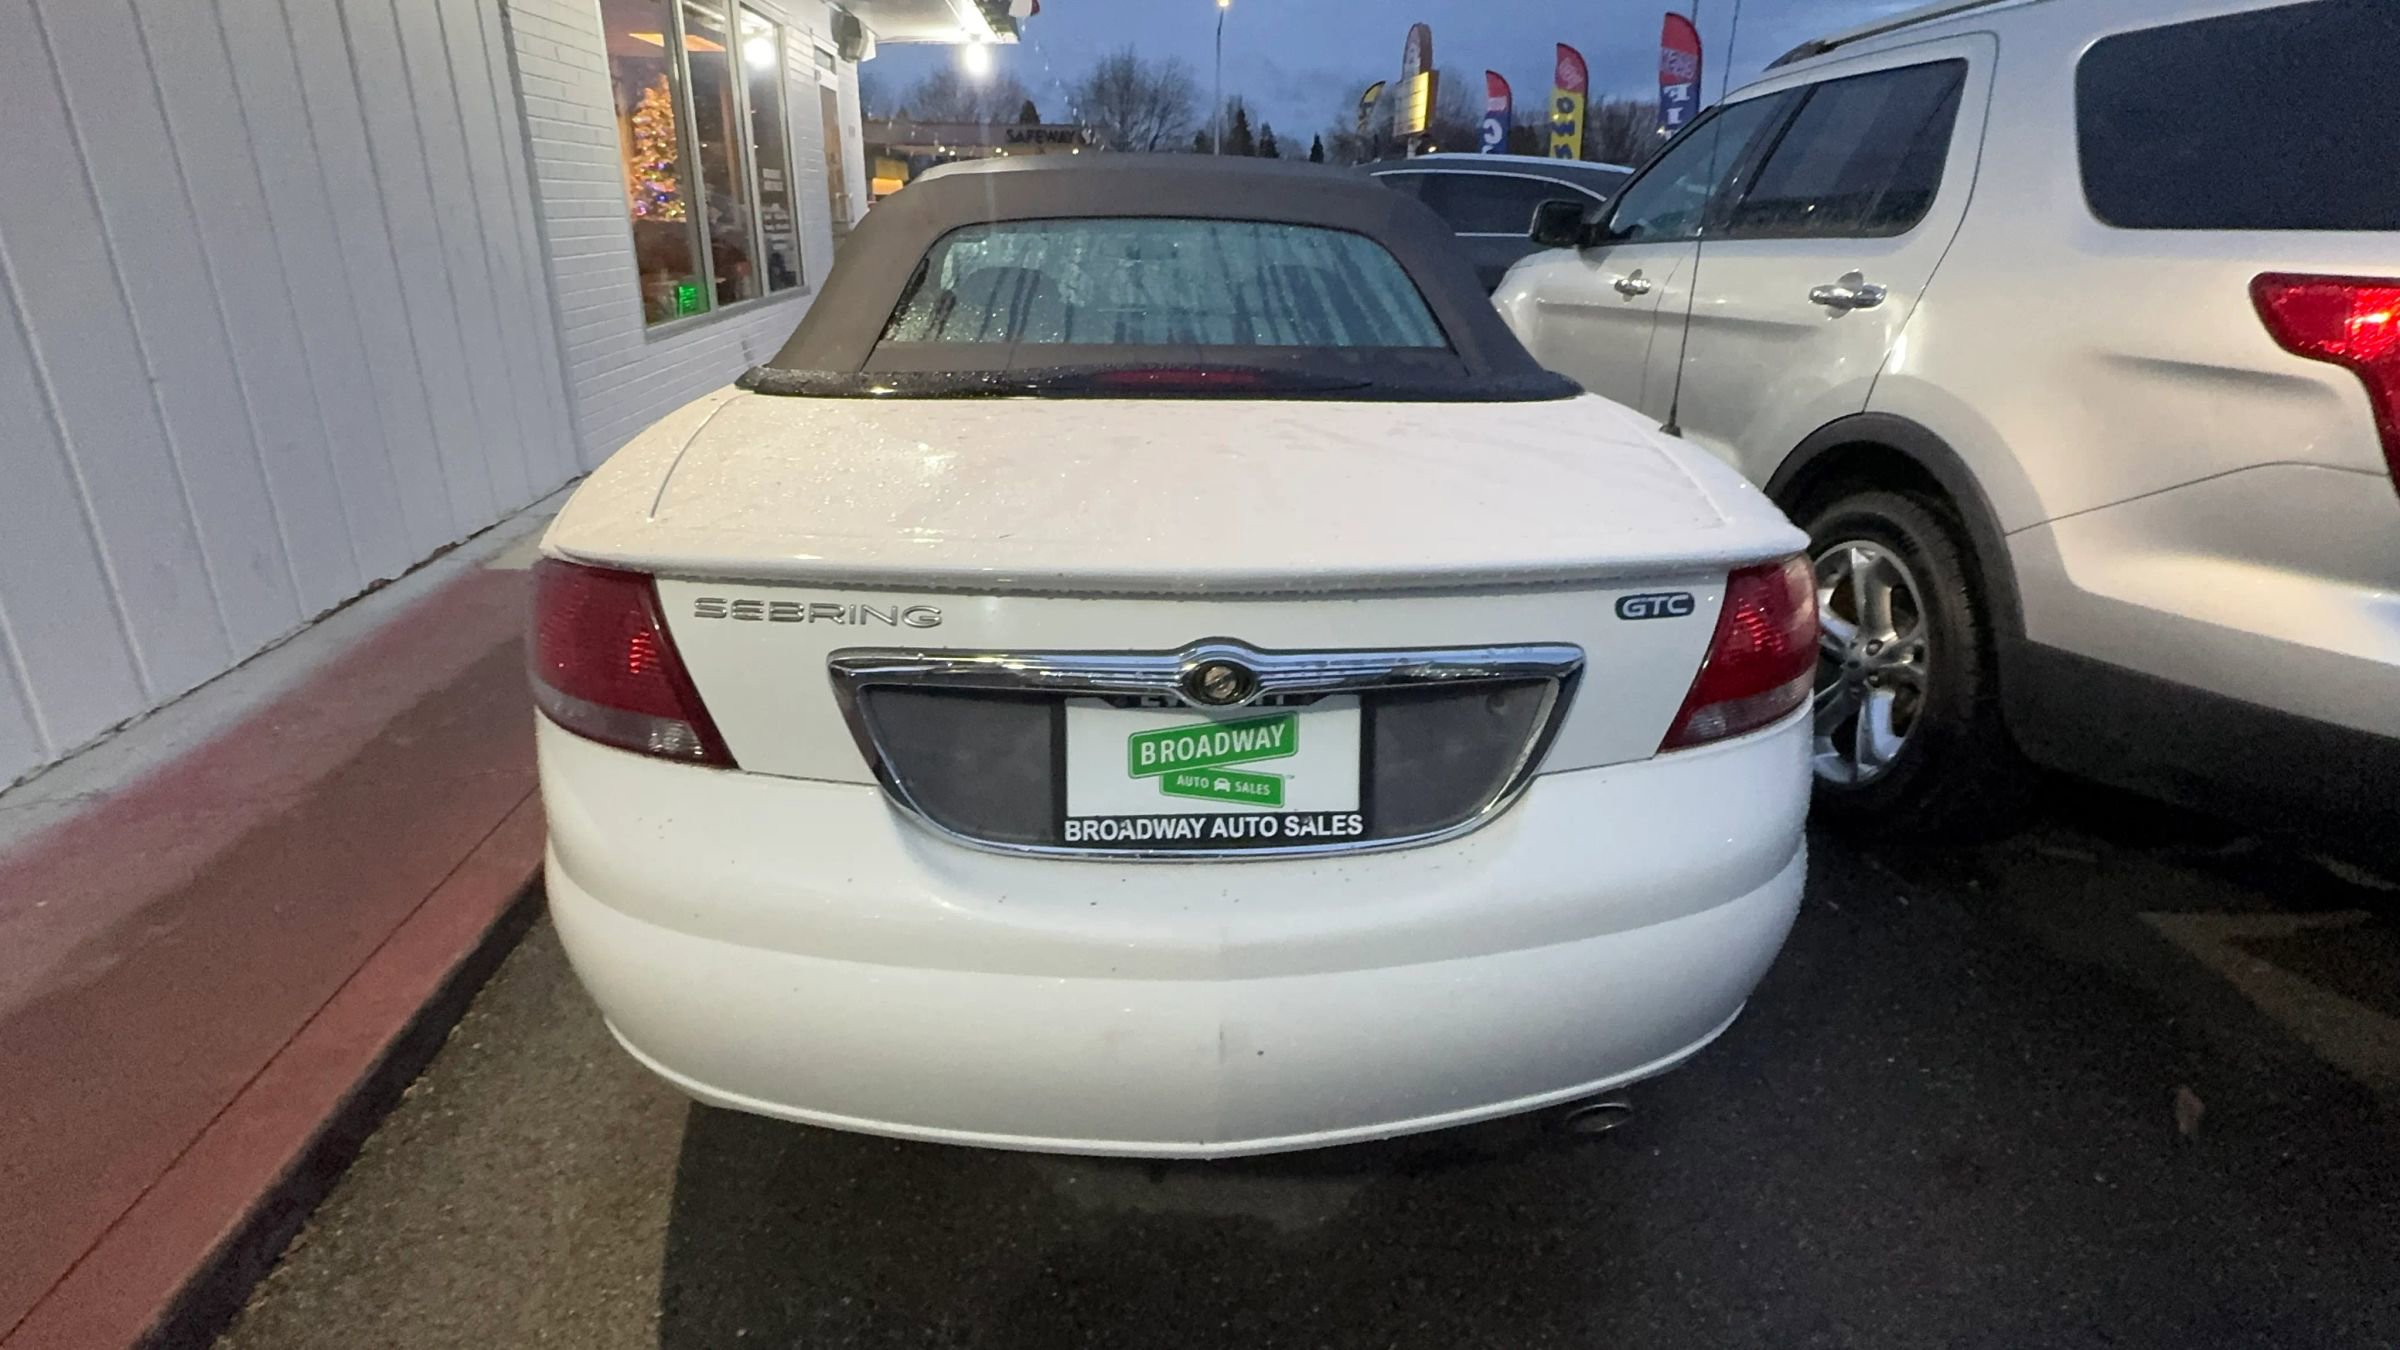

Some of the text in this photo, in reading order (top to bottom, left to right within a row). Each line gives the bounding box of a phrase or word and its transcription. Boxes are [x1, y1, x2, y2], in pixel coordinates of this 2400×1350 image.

[1006, 128, 1076, 144] SAFEWAY
[694, 597, 942, 629] SEBRING
[1622, 594, 1690, 617] GTC
[1140, 723, 1286, 766] BROADWAY
[1176, 774, 1271, 796] AUTO SALES
[1064, 813, 1363, 842] BROADWAY AUTO SALES
